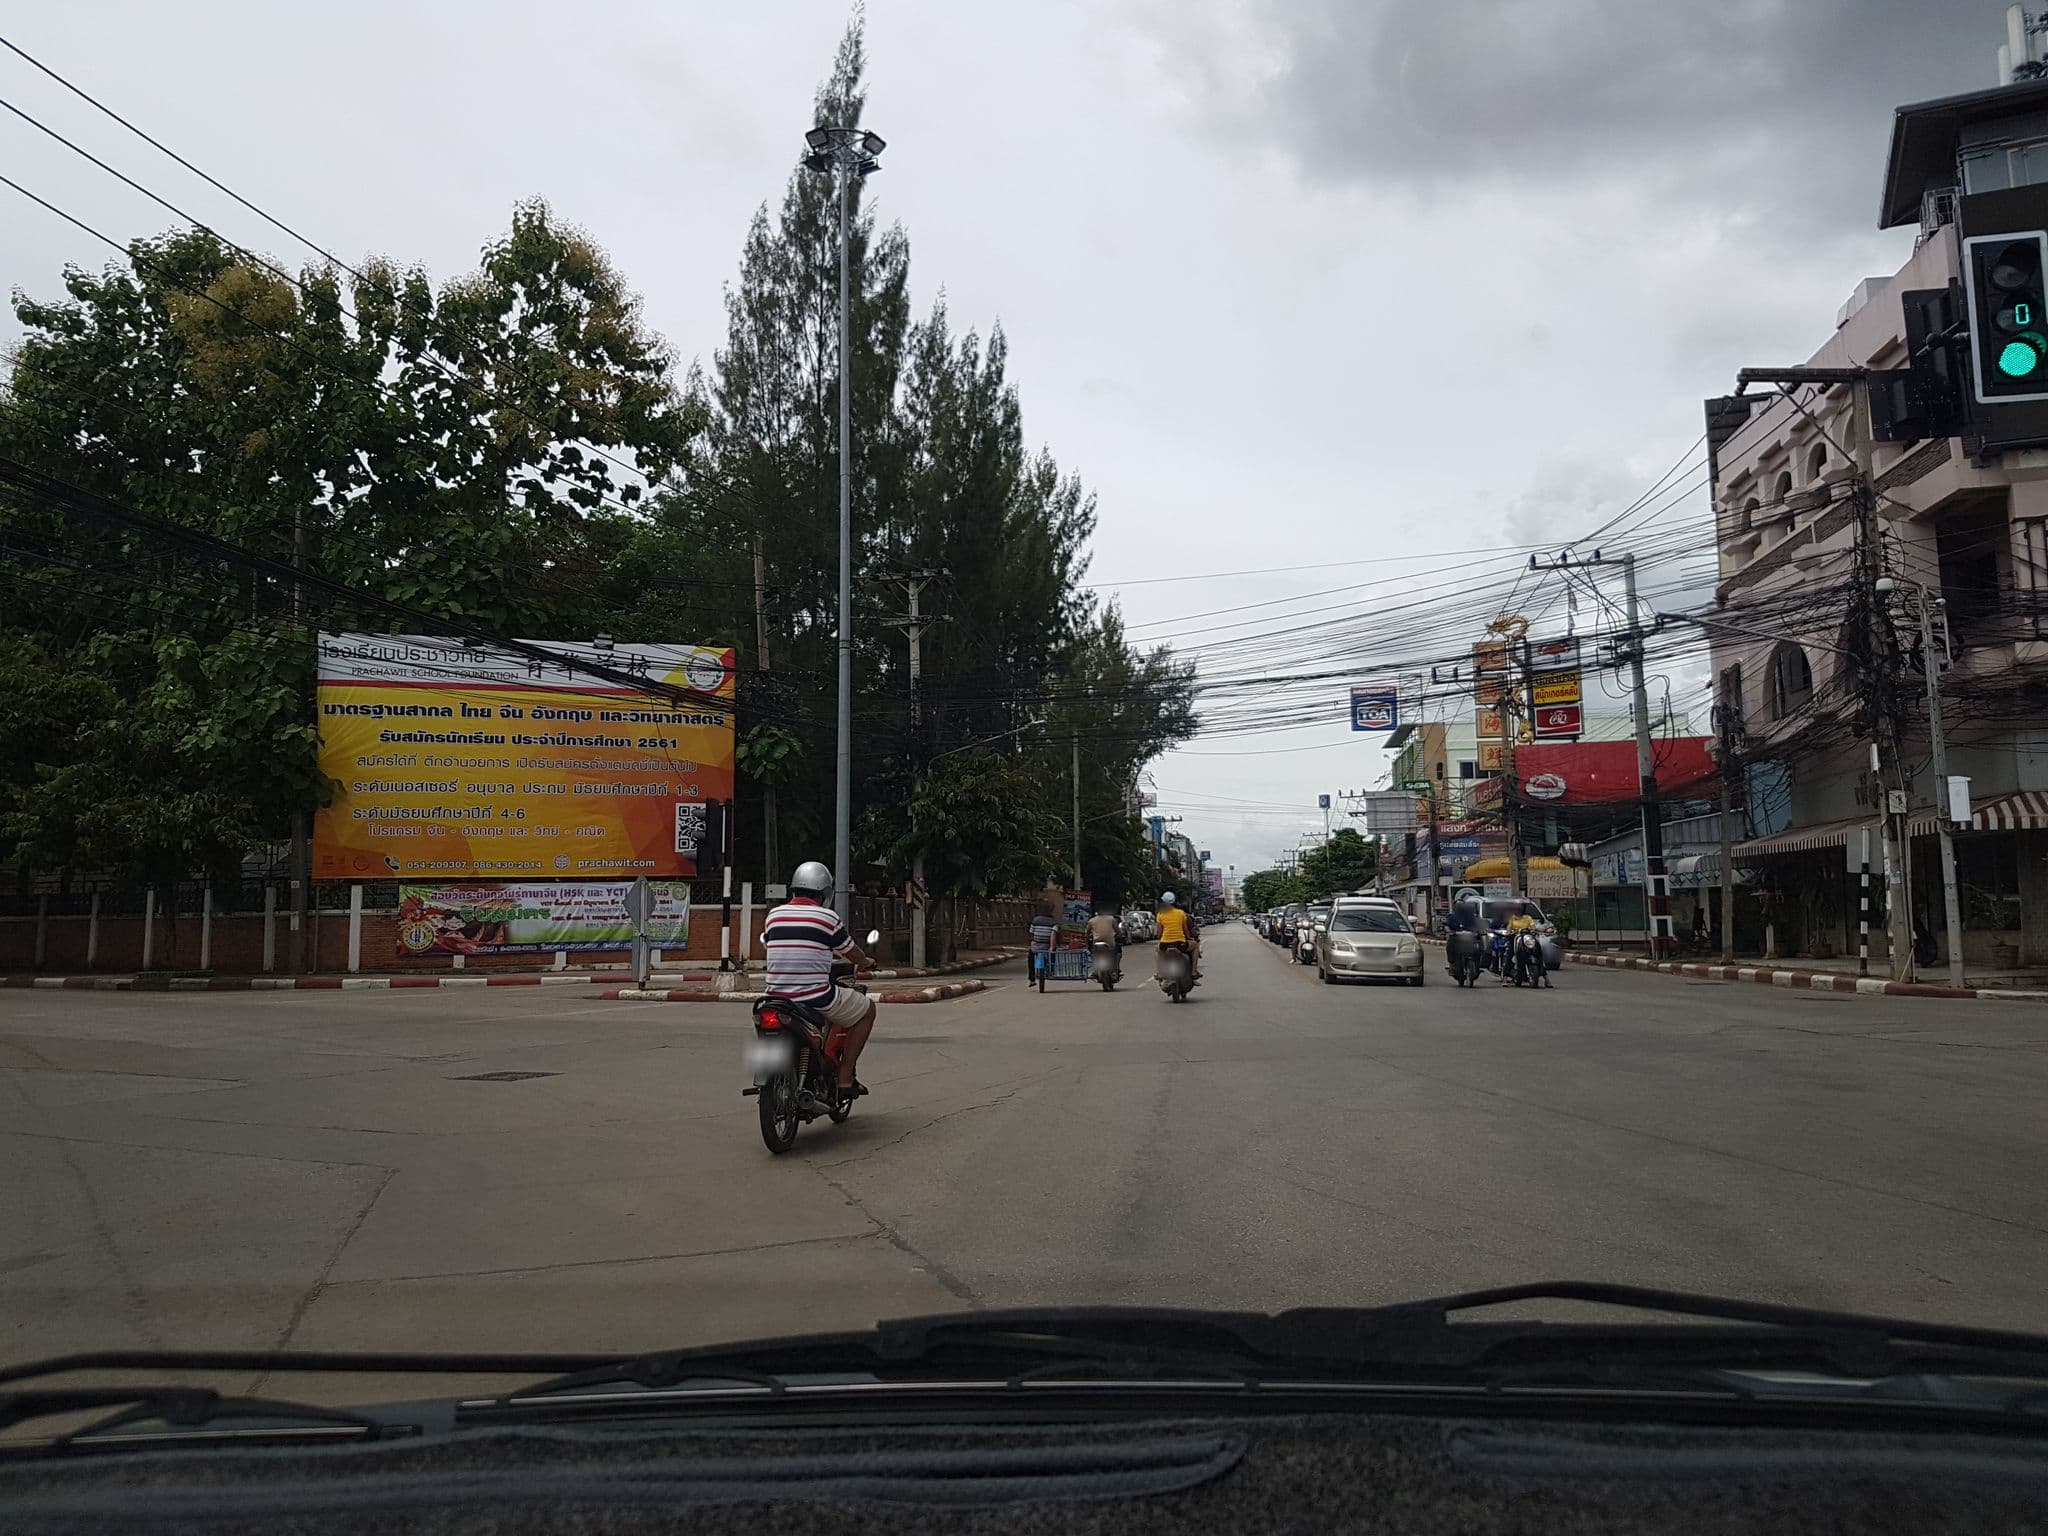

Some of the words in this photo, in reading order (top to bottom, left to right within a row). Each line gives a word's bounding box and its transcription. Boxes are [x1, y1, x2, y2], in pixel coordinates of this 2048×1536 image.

[2014, 303, 2031, 325] 0
[352, 666, 408, 677] PRACHAWIT
[411, 668, 453, 679] SCHOOL
[454, 670, 519, 682] FOUNDATION
[324, 703, 453, 719] มาตรฐานสากล
[459, 702, 492, 718] ไทย
[500, 704, 524, 719] จีน
[531, 705, 593, 723] อังกฤษ
[600, 708, 725, 726] และวิทยาศาสตร์
[1359, 708, 1389, 720] TOA
[379, 730, 505, 745] รับสมัครนักเรียน
[512, 732, 632, 747] ประจำปีการศึกษา
[638, 738, 677, 749] 2561
[357, 753, 417, 767] สมัครได้ที่
[424, 756, 510, 769] ตึกอำนวยการ
[467, 782, 515, 797] อนุบาล
[523, 782, 566, 795] ประถม
[573, 781, 668, 796] มัธยมศึกษาปีที่
[676, 785, 698, 796] 1-3
[352, 805, 493, 820] ระดับมัธยมศึกษาปีที่
[501, 808, 526, 820] 4-6
[368, 824, 421, 836] โปรแกรม
[428, 825, 445, 836] จีน
[462, 825, 504, 838] อังกฤษ
[510, 826, 528, 836] และ
[577, 858, 656, 870] prachawit.com
[560, 888, 584, 899] (HSK
[606, 887, 628, 897] YCT)
